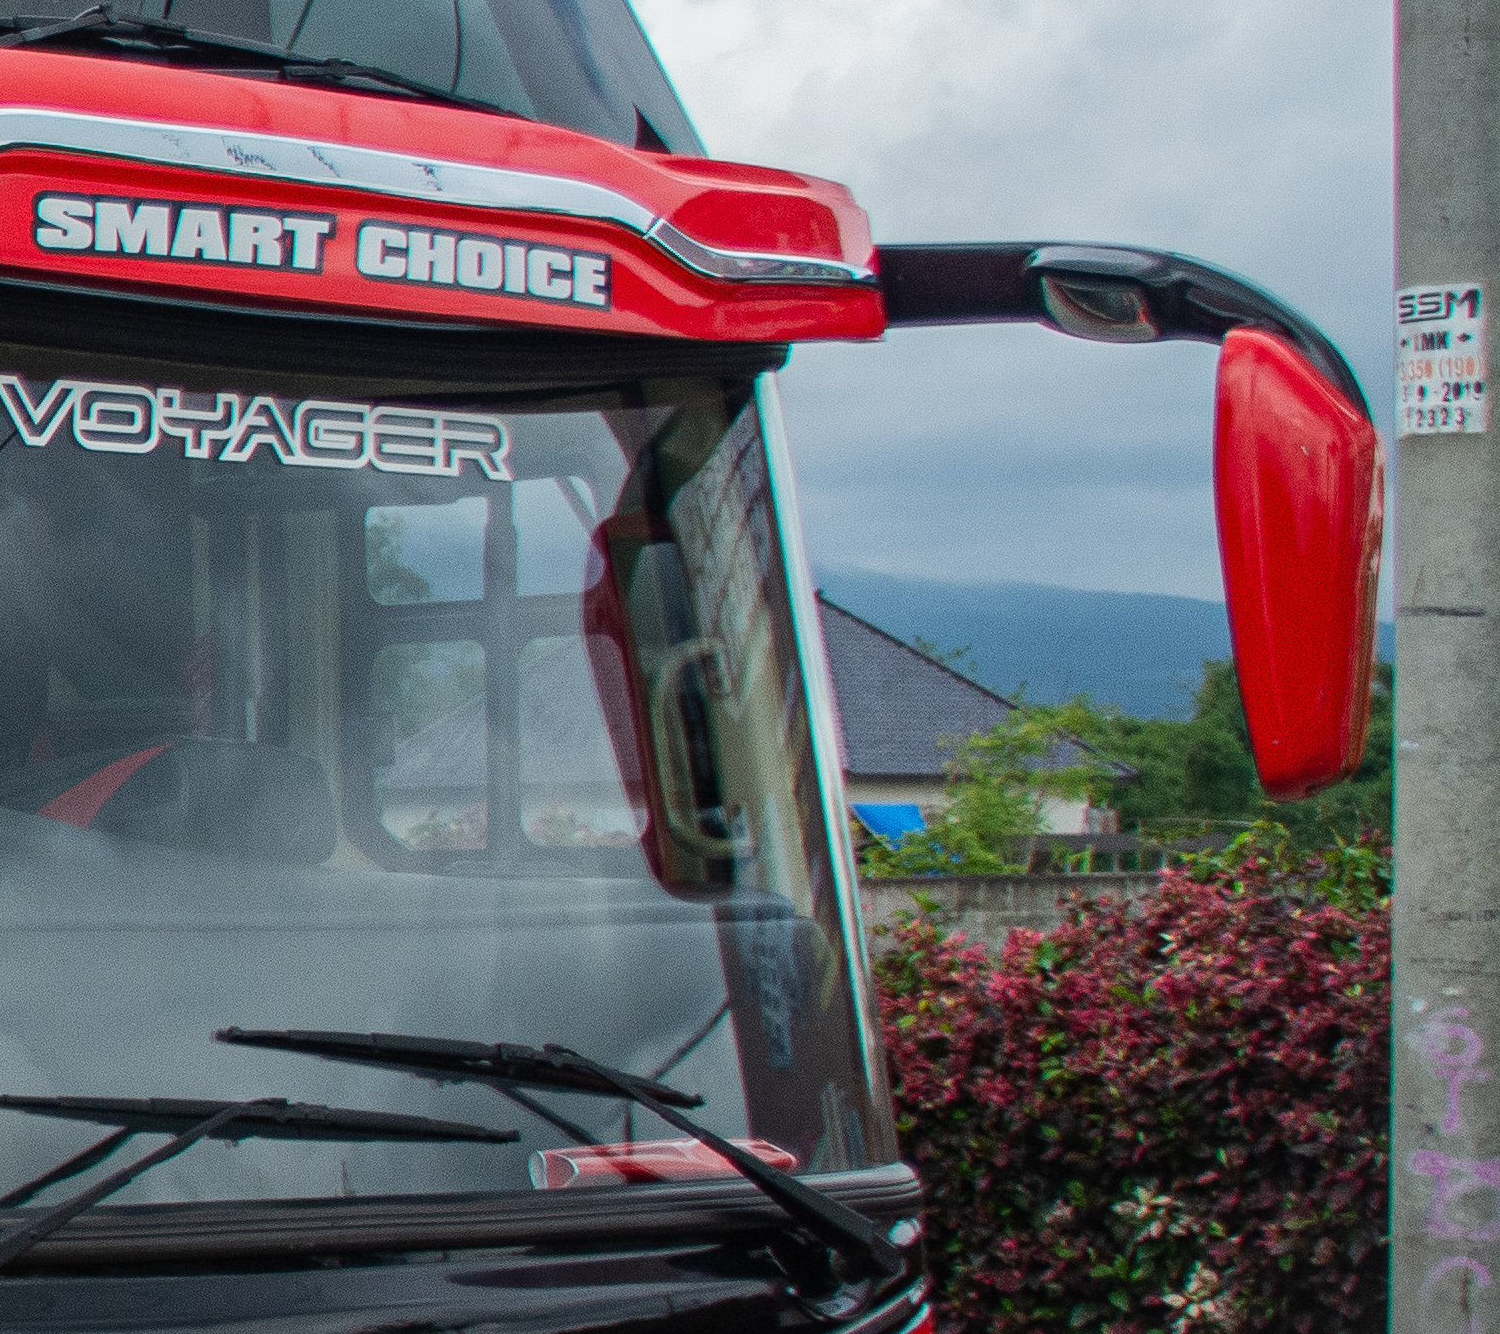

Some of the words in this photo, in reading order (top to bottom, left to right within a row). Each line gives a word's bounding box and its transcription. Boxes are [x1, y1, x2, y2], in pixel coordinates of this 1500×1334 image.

[33, 191, 336, 274] SMART
[356, 220, 611, 311] CHOICE
[1398, 288, 1481, 321] SSM
